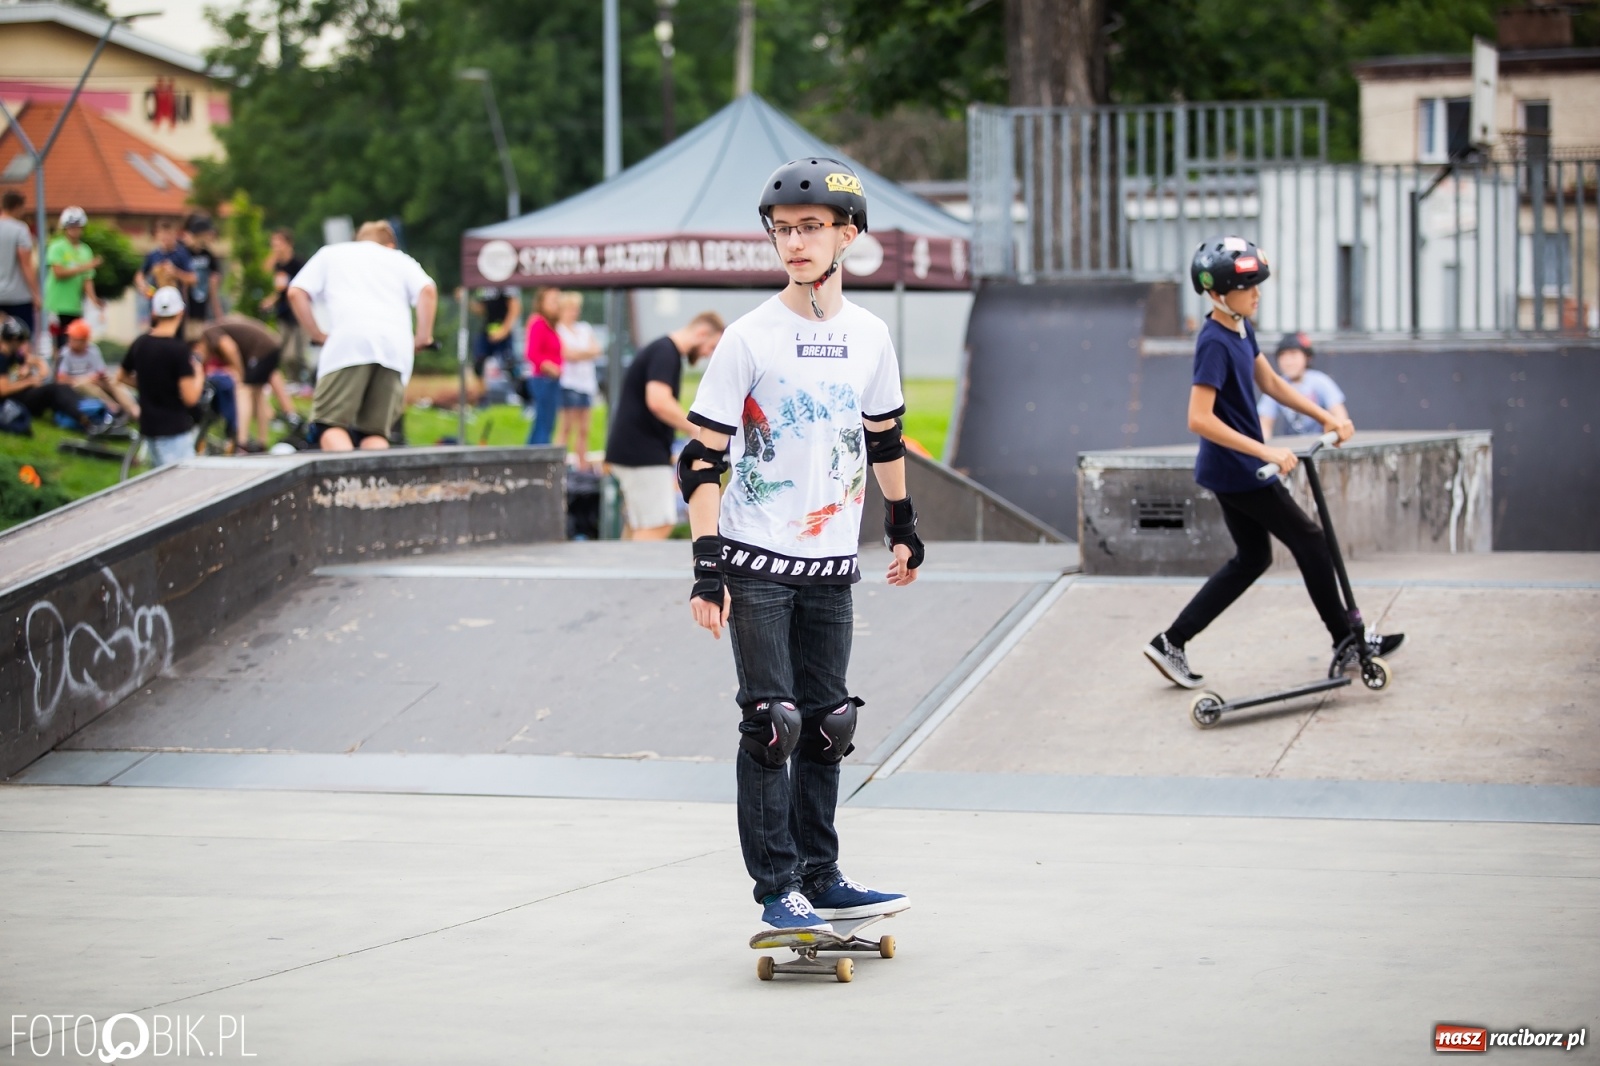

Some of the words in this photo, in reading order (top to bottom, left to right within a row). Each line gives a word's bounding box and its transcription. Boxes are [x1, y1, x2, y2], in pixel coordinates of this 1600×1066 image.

[602, 241, 668, 273] JAZDY
[668, 240, 702, 271] NA
[796, 333, 847, 342] LIVE
[802, 345, 844, 357] BREATHE
[700, 560, 717, 569] FILA
